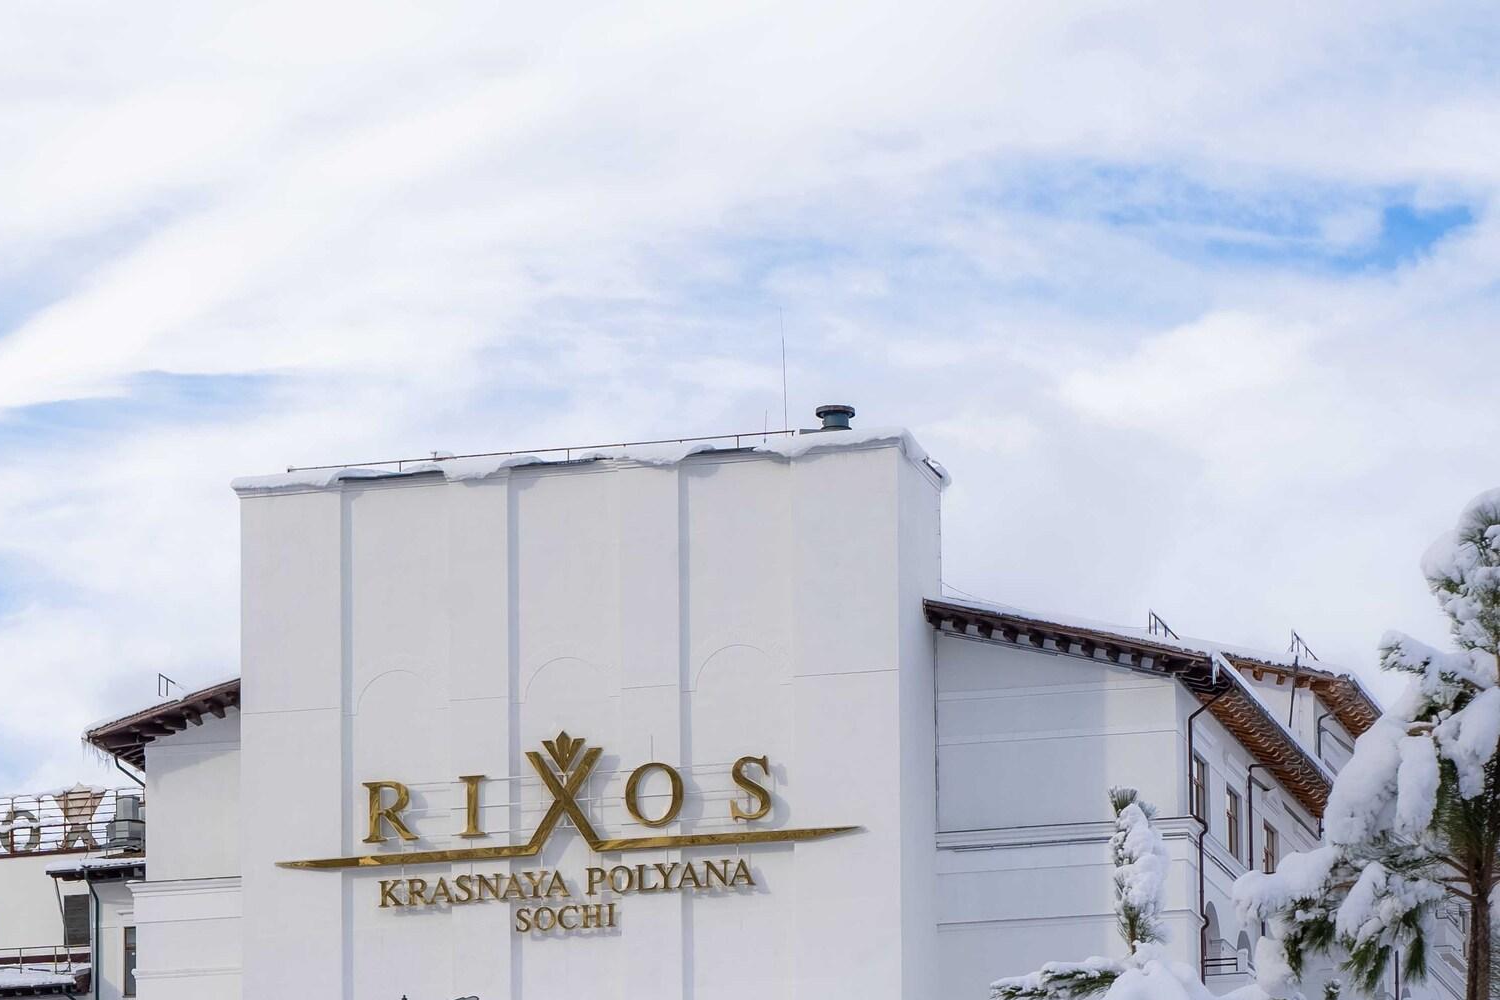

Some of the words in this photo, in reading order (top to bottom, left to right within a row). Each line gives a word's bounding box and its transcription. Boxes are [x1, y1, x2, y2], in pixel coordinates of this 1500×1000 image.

[362, 731, 772, 855] RIXOS
[379, 870, 571, 908] KRASNAYA
[586, 859, 756, 896] POLYANA
[516, 903, 617, 933] SOCHI
